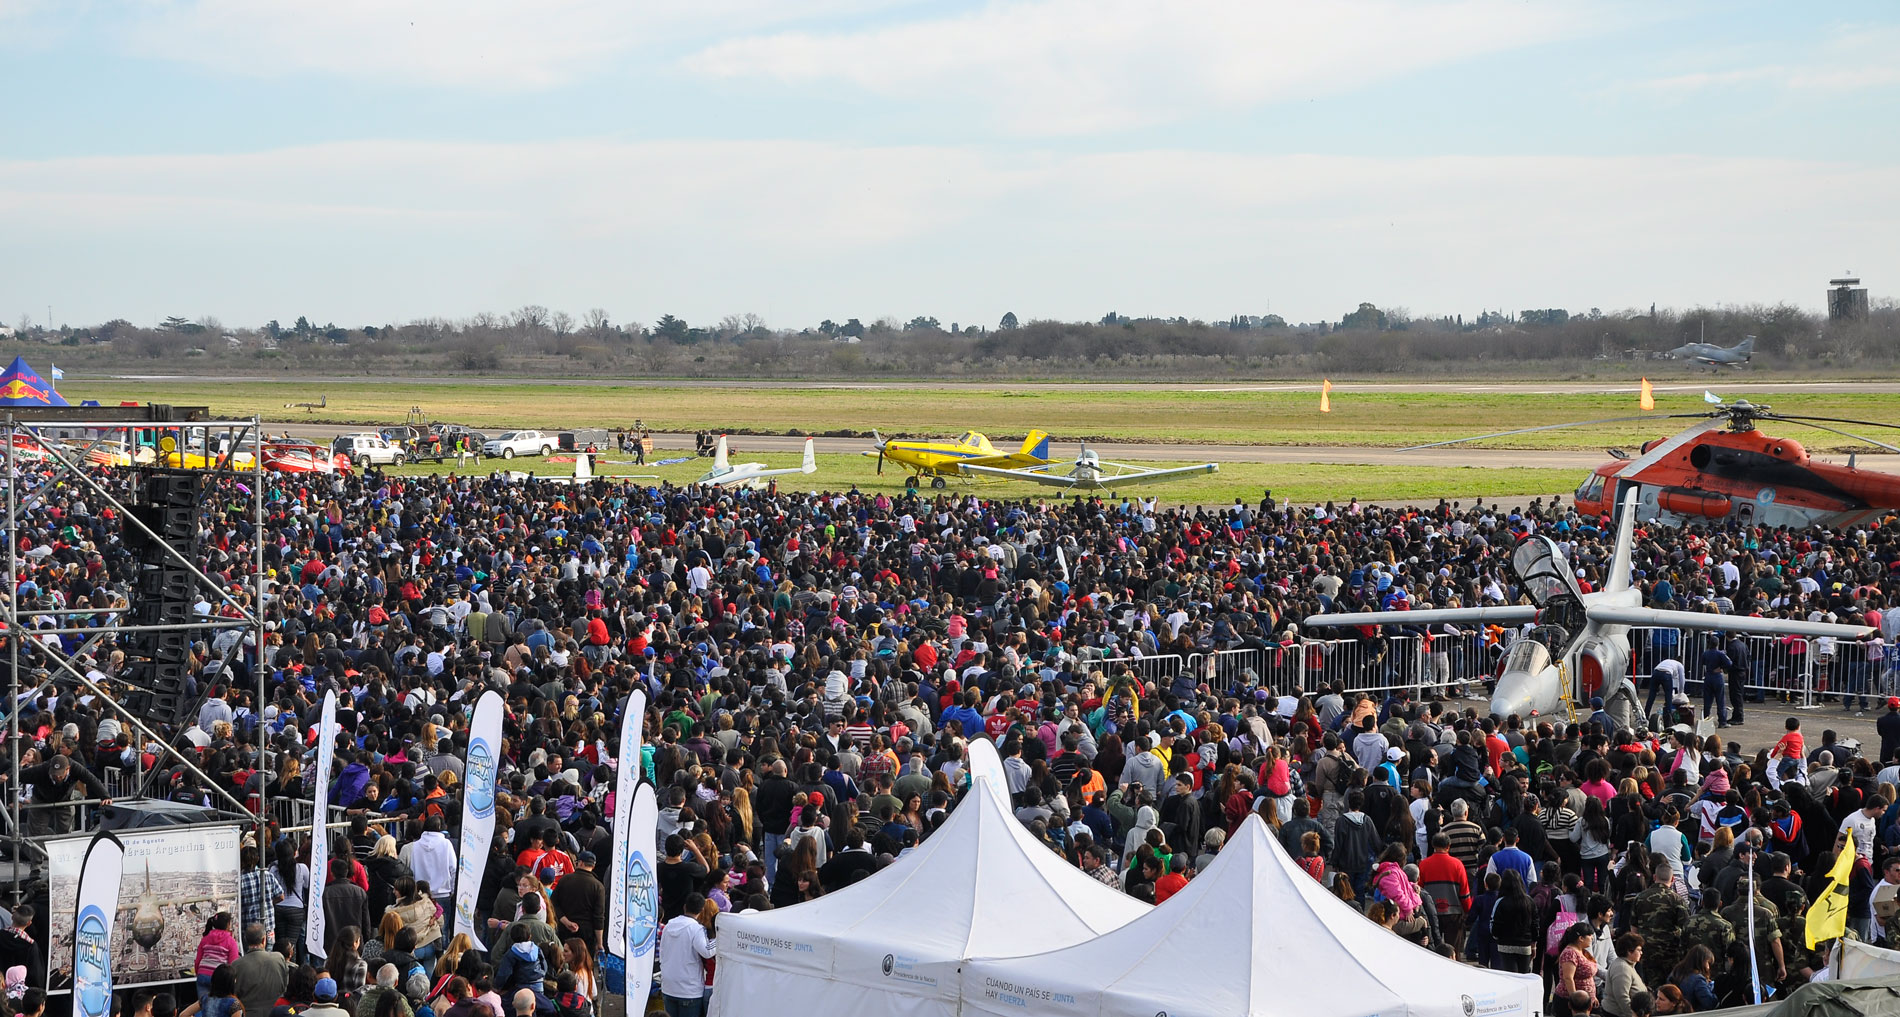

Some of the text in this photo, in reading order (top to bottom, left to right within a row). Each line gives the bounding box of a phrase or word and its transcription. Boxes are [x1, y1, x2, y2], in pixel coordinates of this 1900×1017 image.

[17, 372, 37, 384] Bull
[626, 713, 635, 762] JUNTA
[155, 842, 205, 856] Argentina
[215, 840, 234, 850] 2010
[737, 930, 814, 953] CUANDO UN PAÍS SE JUNTA
[737, 941, 773, 956] HAY FUERZA
[79, 943, 107, 977] VUELA
[985, 977, 1075, 1004] CUANDO UN PAÍS SE JUNTA
[985, 988, 1026, 1007] HAY FUERZA
